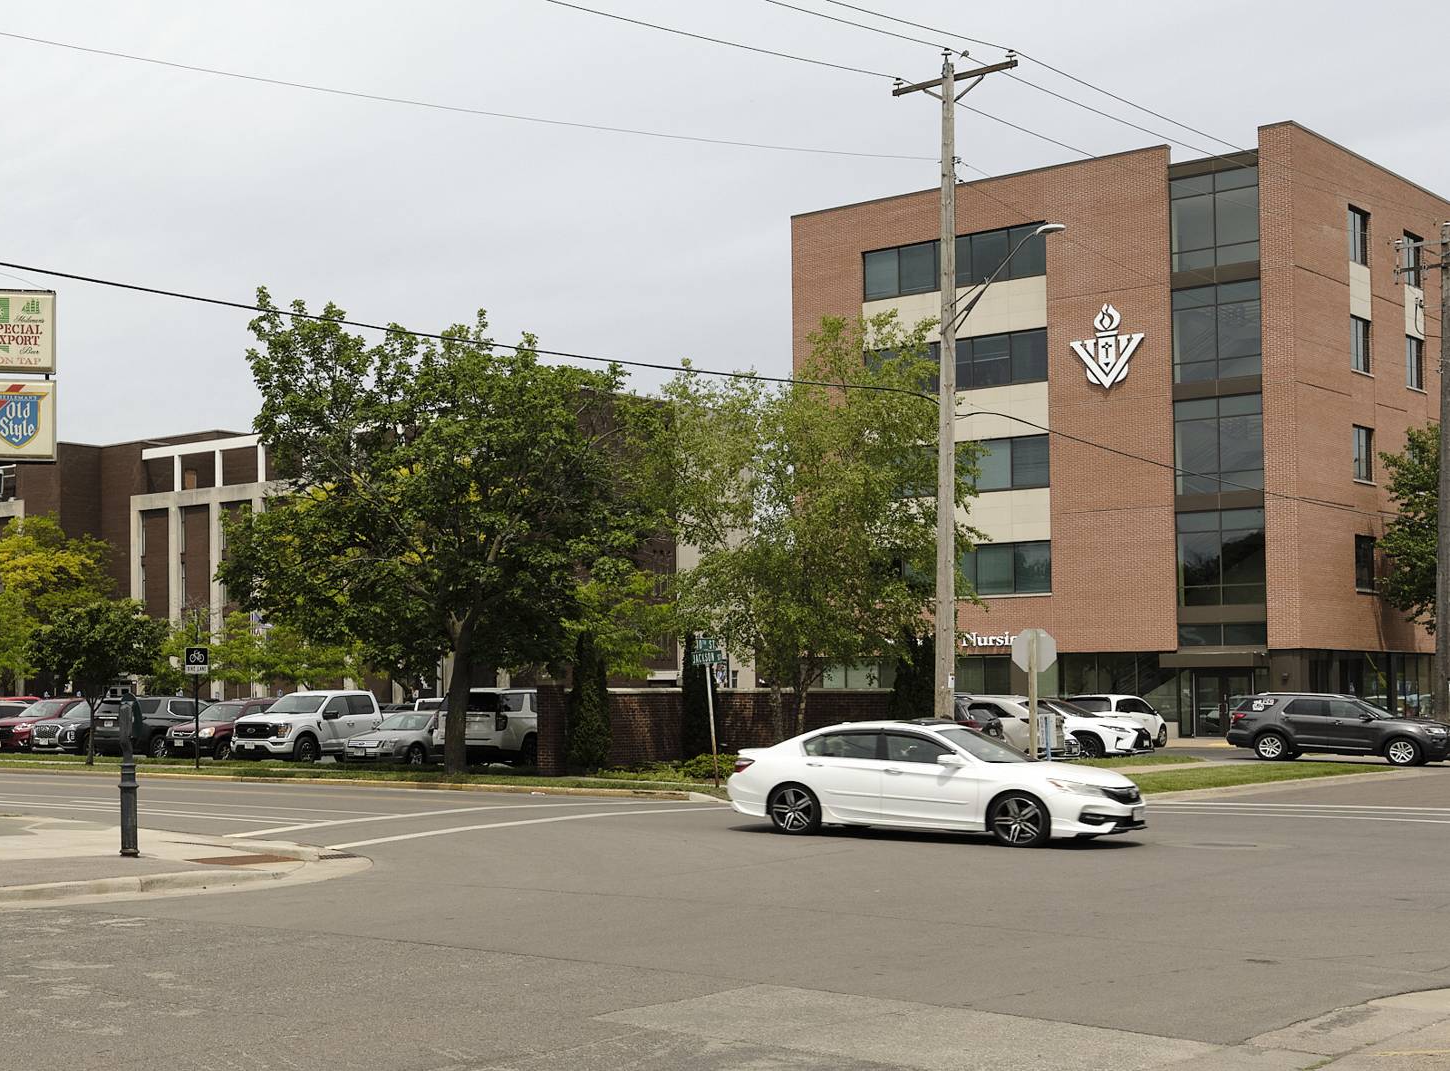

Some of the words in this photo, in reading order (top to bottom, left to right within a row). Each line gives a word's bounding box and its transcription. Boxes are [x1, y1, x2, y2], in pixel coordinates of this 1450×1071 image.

[17, 357, 41, 366] TAP
[6, 402, 31, 420] Old
[0, 417, 35, 443] Style
[692, 651, 714, 664] JACKSON
